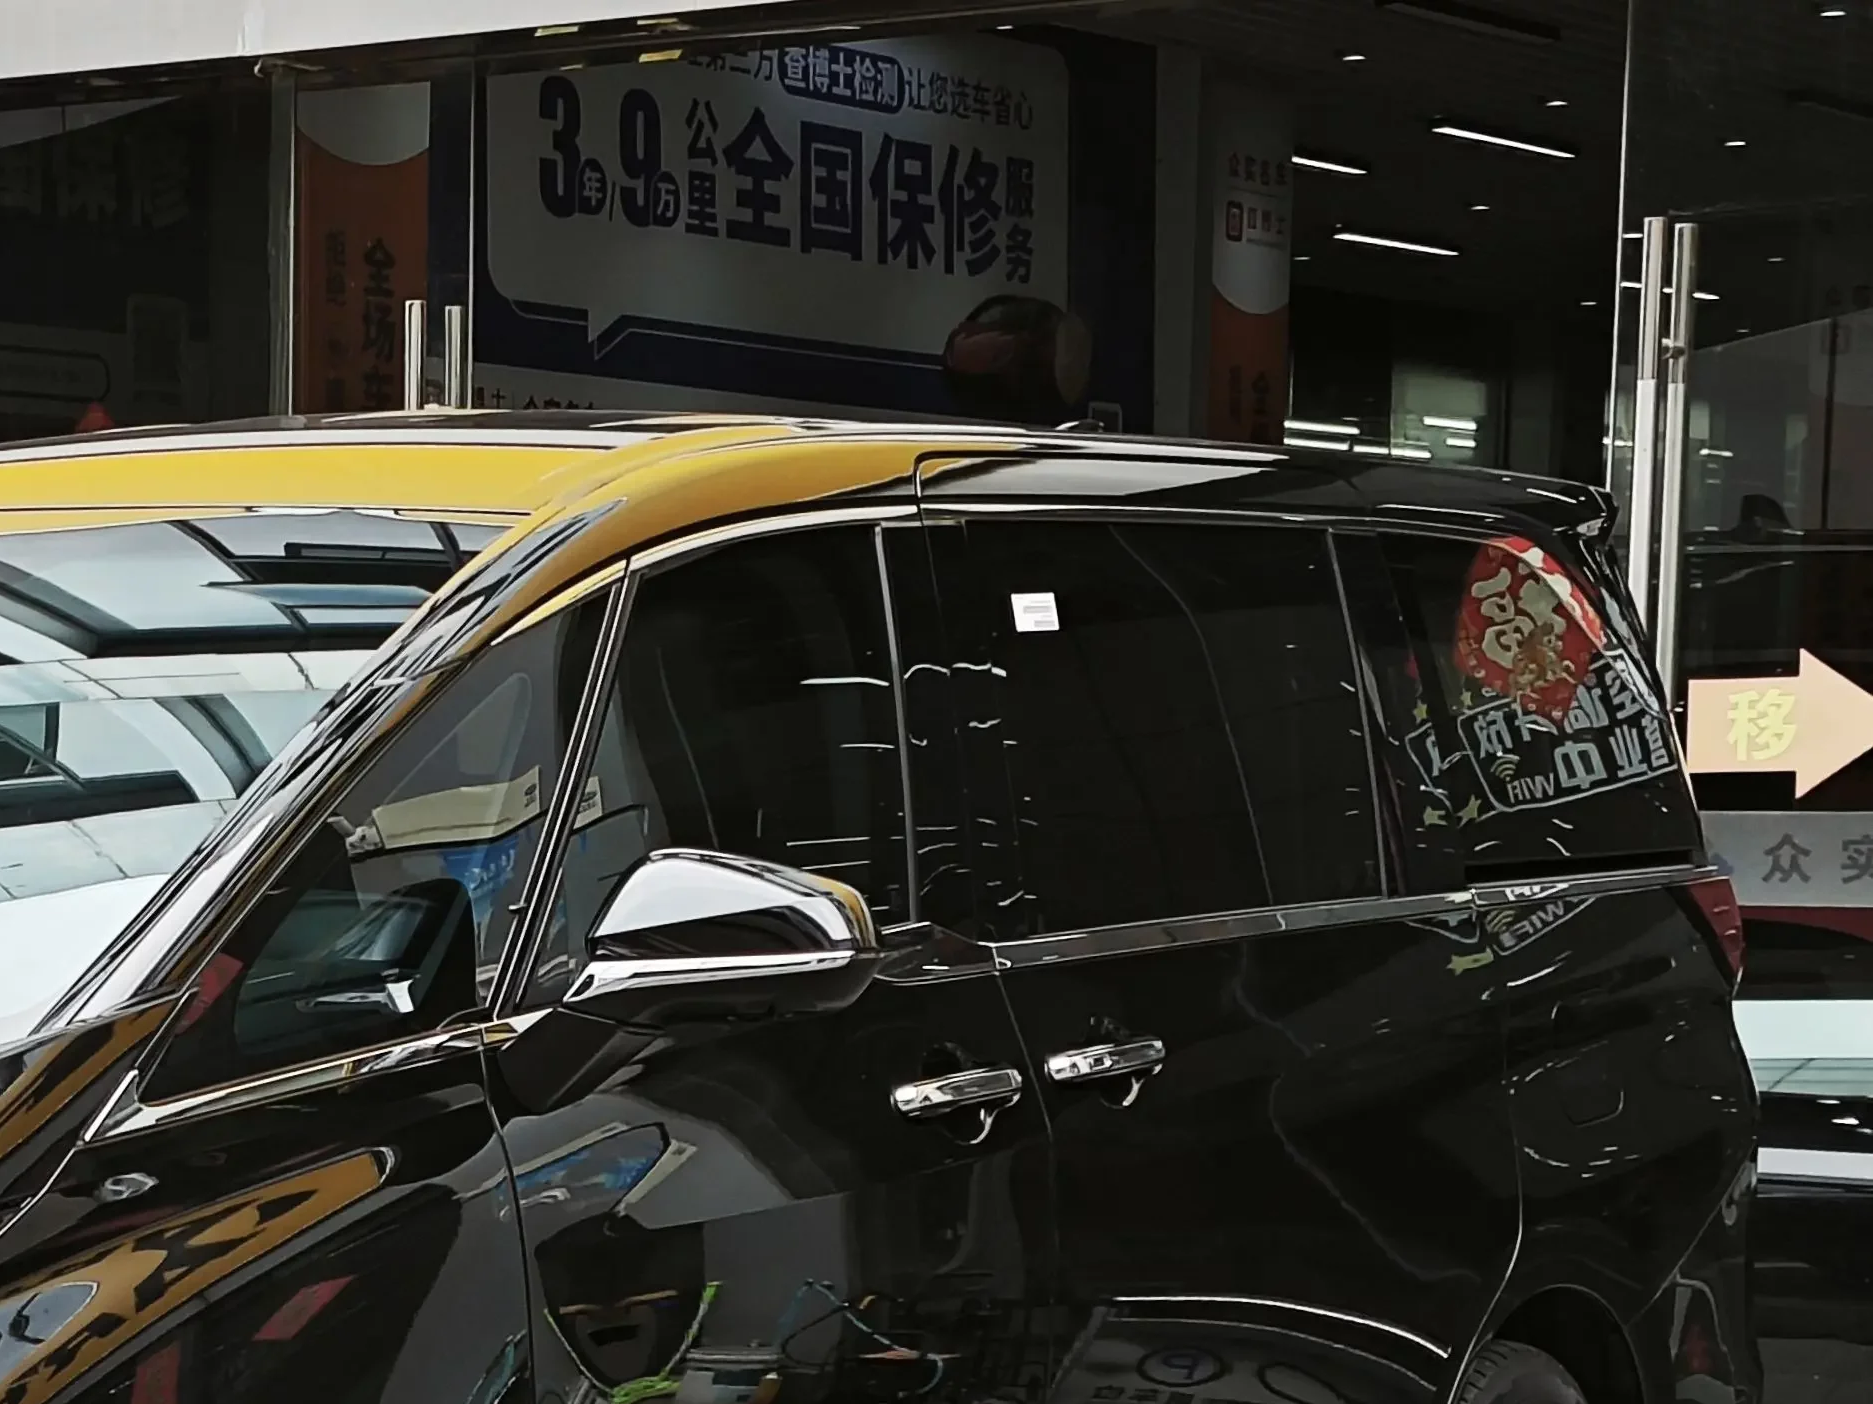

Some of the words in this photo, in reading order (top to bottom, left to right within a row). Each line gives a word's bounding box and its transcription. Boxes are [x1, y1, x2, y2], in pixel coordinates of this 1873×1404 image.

[783, 45, 899, 108] 查博士检测
[904, 66, 1034, 131] 让您选车省心
[684, 97, 720, 238] 公里
[722, 105, 1003, 277] 全国保修
[1005, 155, 1034, 285] 服务
[1726, 688, 1798, 762] 移
